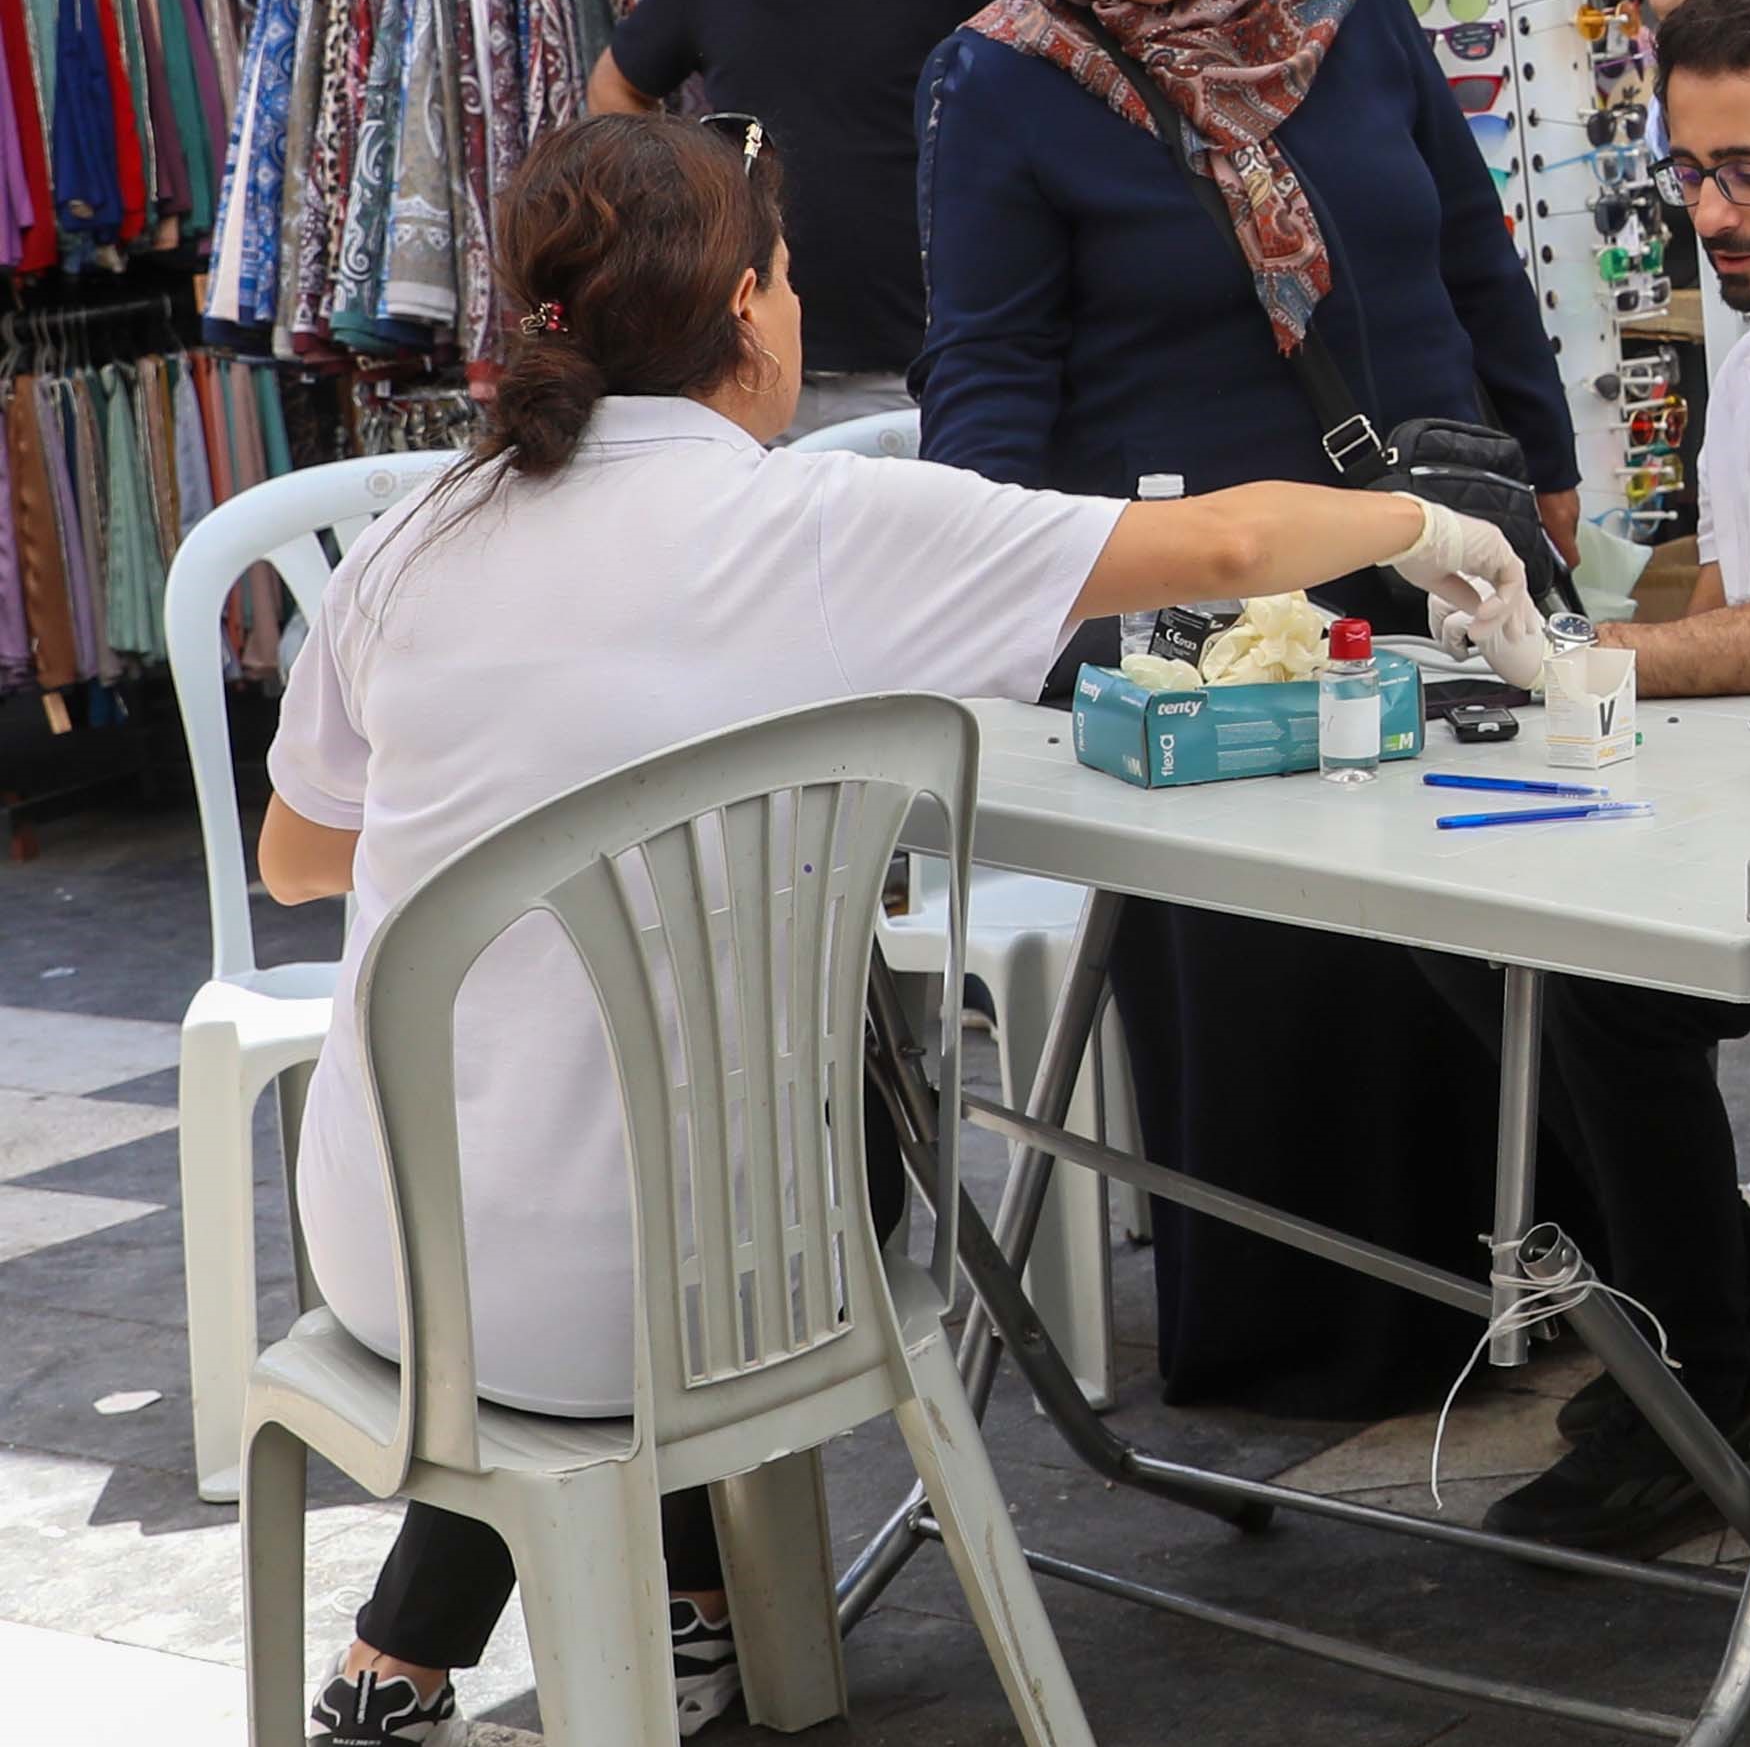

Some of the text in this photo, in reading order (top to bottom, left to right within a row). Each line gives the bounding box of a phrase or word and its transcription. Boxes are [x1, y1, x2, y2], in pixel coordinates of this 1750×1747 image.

[1080, 678, 1101, 702] tenty
[1158, 700, 1201, 717] tenty
[1399, 732, 1414, 749] M
[1160, 734, 1175, 777] flexa
